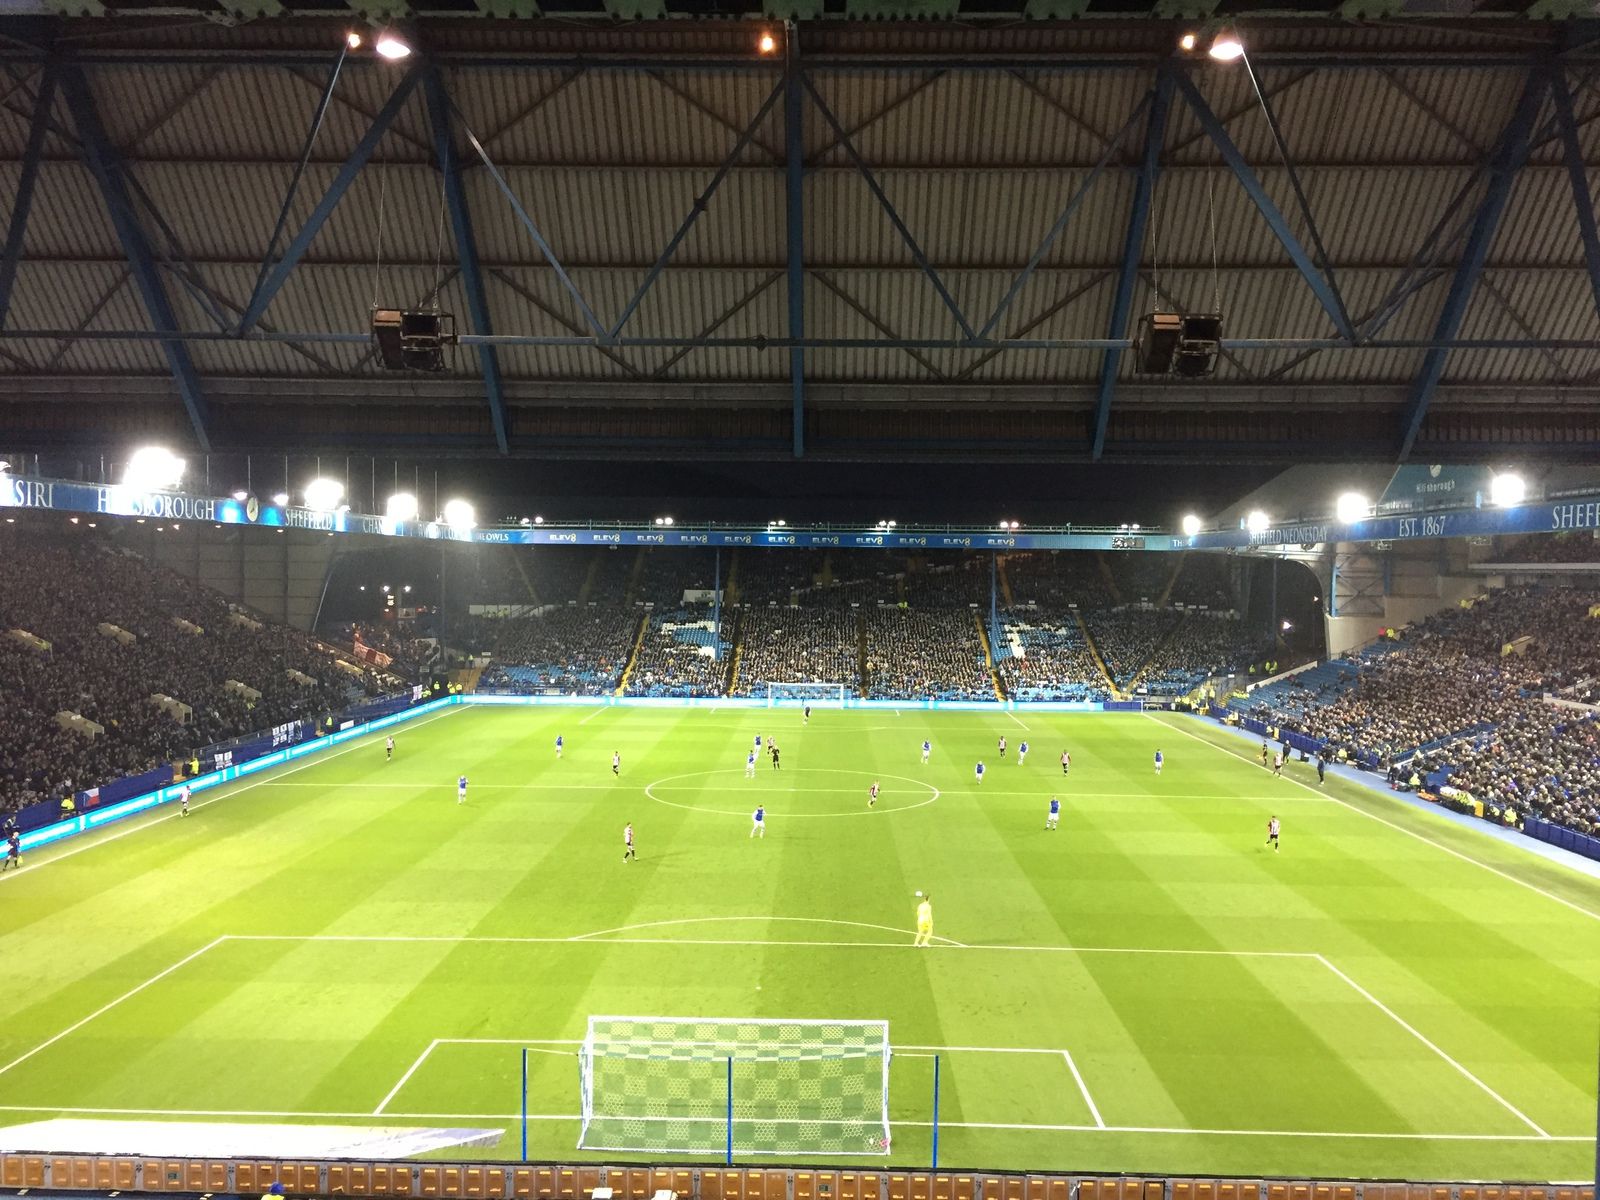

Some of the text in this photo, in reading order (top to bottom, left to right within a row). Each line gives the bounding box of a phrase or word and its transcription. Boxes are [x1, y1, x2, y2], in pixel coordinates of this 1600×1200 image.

[1399, 515, 1447, 537] EST. 1867
[486, 533, 509, 541] OWLS
[593, 534, 621, 543] ELEV8
[637, 534, 664, 543] ELEV8
[680, 535, 708, 544] ELEV8
[724, 535, 752, 544] ELEV8
[768, 536, 796, 545] ELEV8
[812, 536, 840, 545] ELEV8
[856, 536, 883, 545] ELEV8
[899, 537, 927, 546] ELEV8
[943, 537, 971, 546] ELEV8
[1283, 526, 1328, 544] WEDNESDAY
